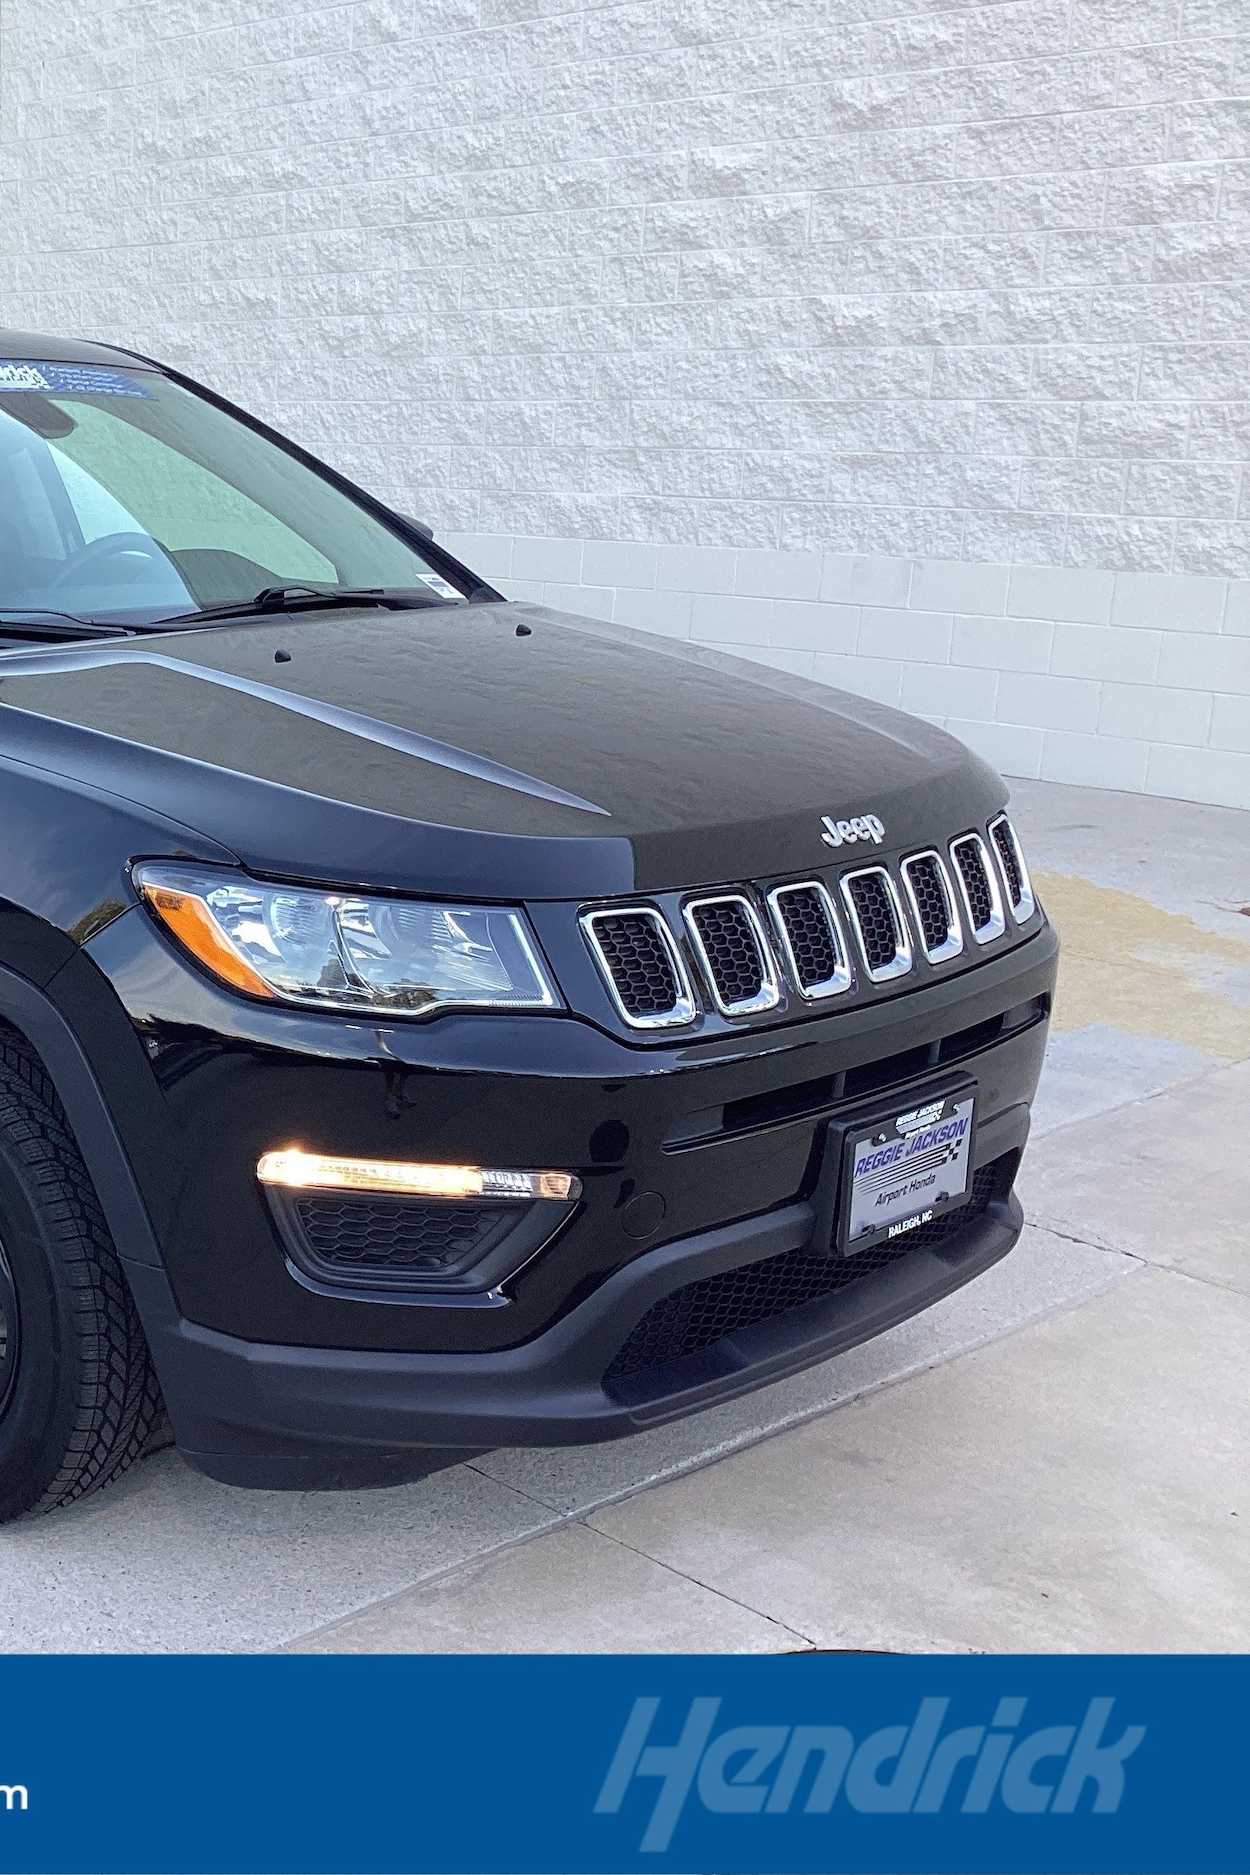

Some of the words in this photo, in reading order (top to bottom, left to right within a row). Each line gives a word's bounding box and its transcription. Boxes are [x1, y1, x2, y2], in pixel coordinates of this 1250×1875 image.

[820, 814, 886, 848] Jeep
[854, 1142, 906, 1178] REGGIE
[905, 1117, 970, 1158] JACKSON
[874, 1188, 908, 1207] Airport
[909, 1173, 937, 1193] Honda
[921, 1210, 933, 1224] NC
